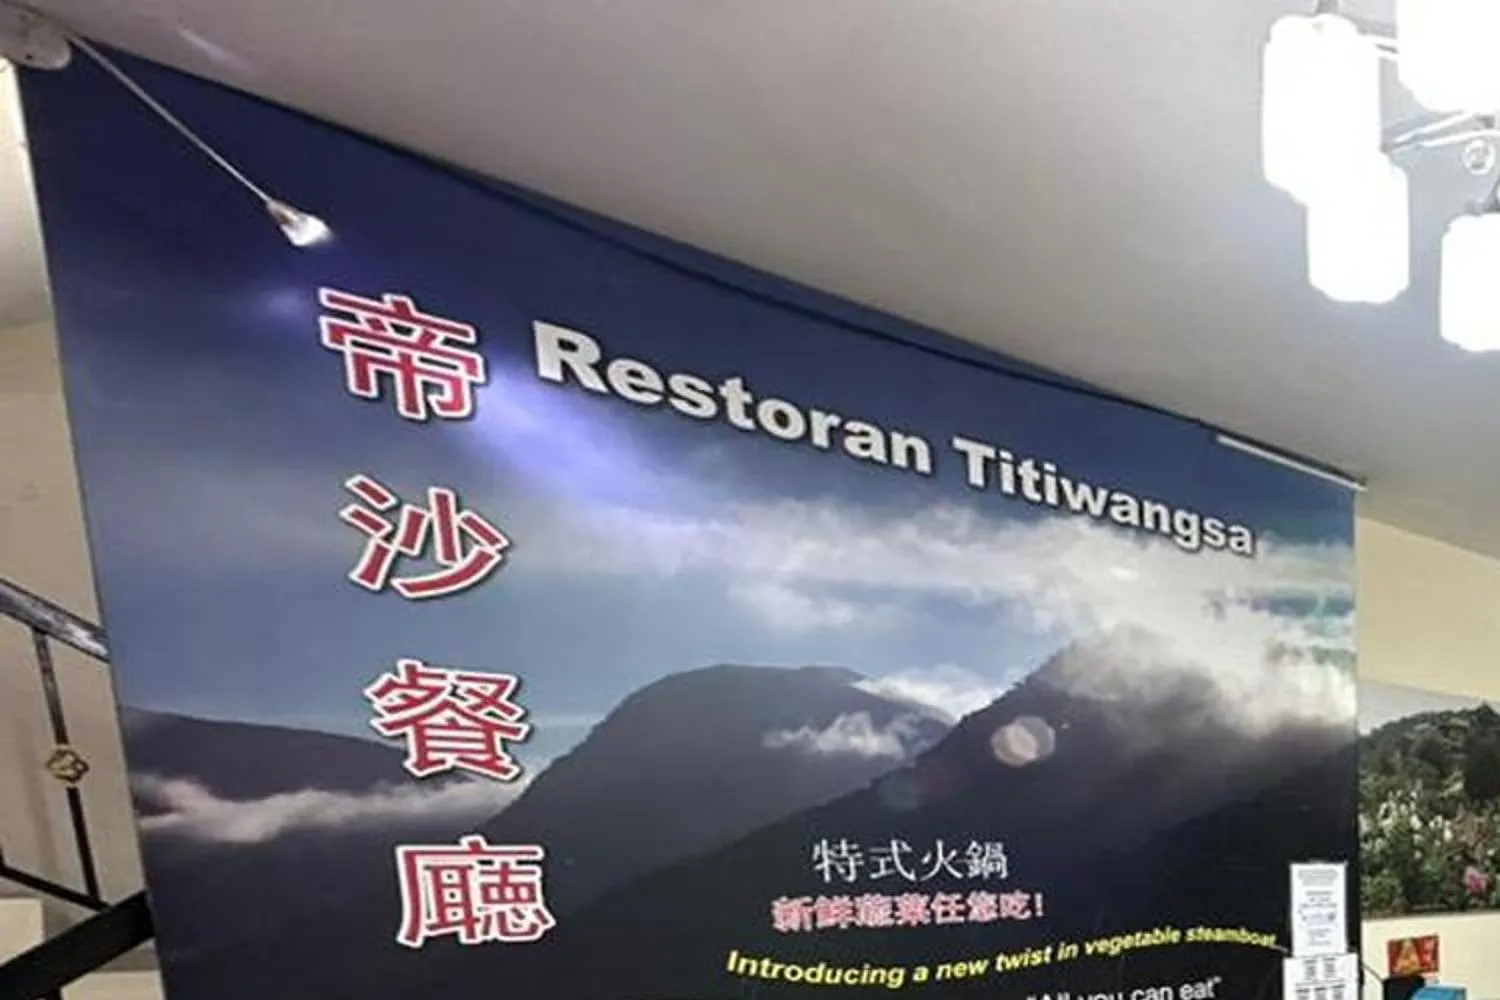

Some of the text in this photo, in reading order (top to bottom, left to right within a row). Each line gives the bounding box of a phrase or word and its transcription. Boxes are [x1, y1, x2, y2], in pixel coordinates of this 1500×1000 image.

[532, 319, 1256, 557] Restoran Titiwangsa
[812, 838, 1008, 883] 特式火鍋
[726, 925, 1277, 989] Introducing a new twist in vegetable steamboat
